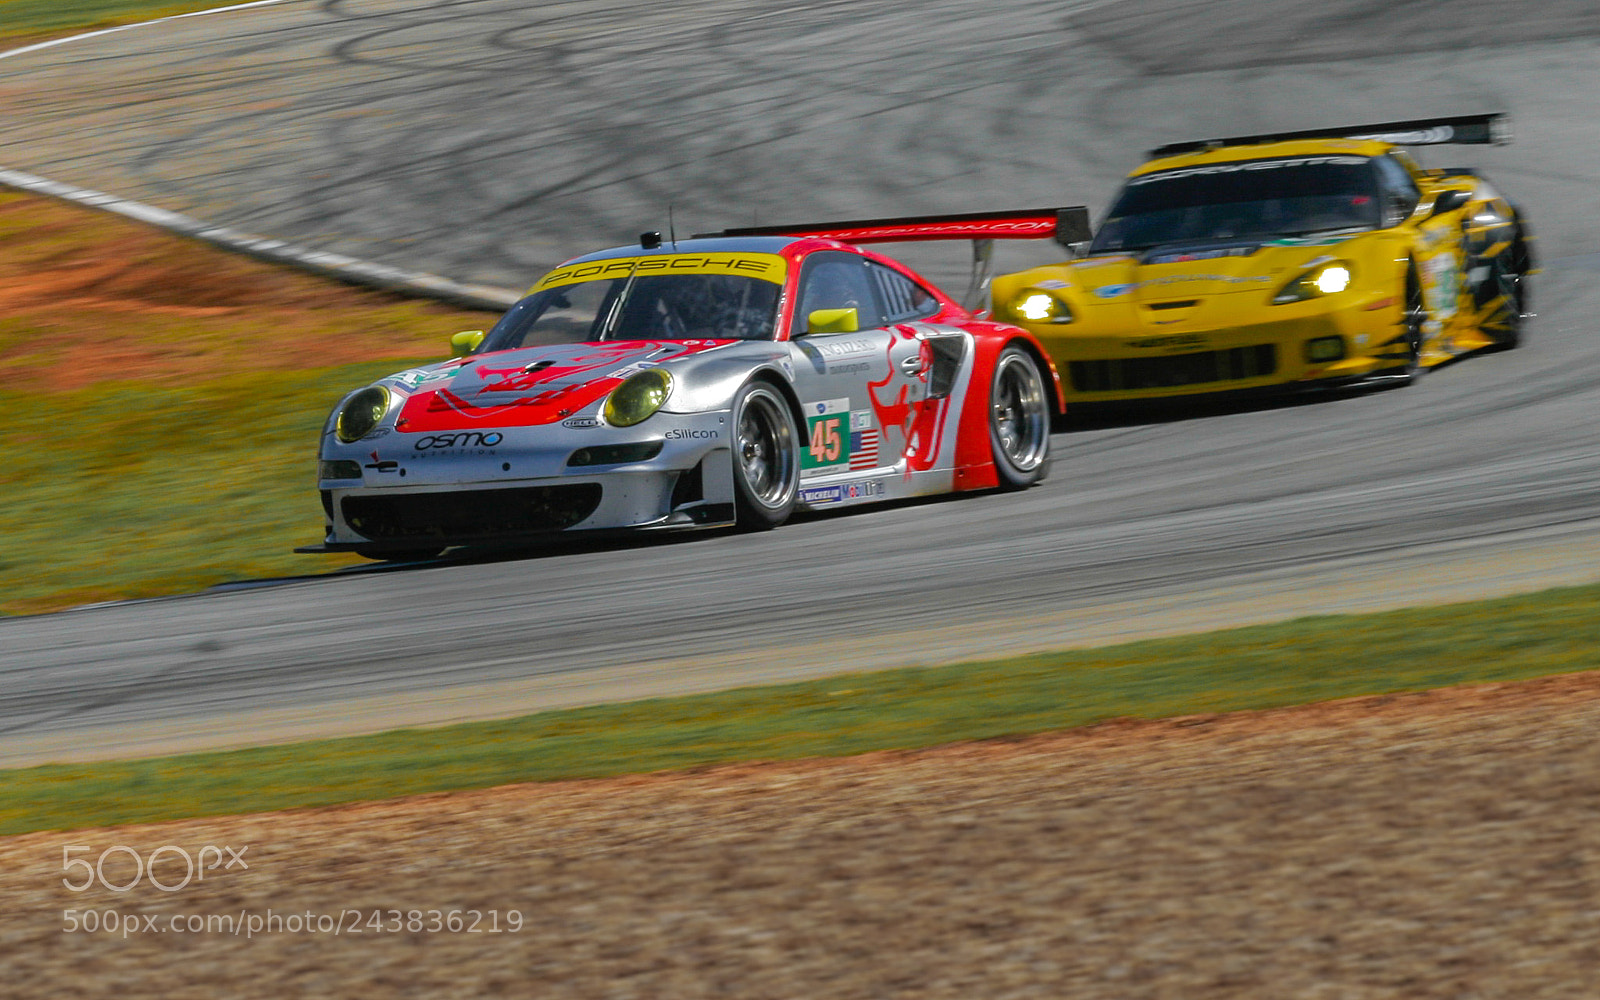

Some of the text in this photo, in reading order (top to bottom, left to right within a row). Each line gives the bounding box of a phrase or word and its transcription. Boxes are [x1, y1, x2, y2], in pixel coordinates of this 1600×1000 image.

[541, 257, 770, 287] PORSCHE
[664, 428, 719, 440] eSilicon
[810, 418, 840, 463] 45
